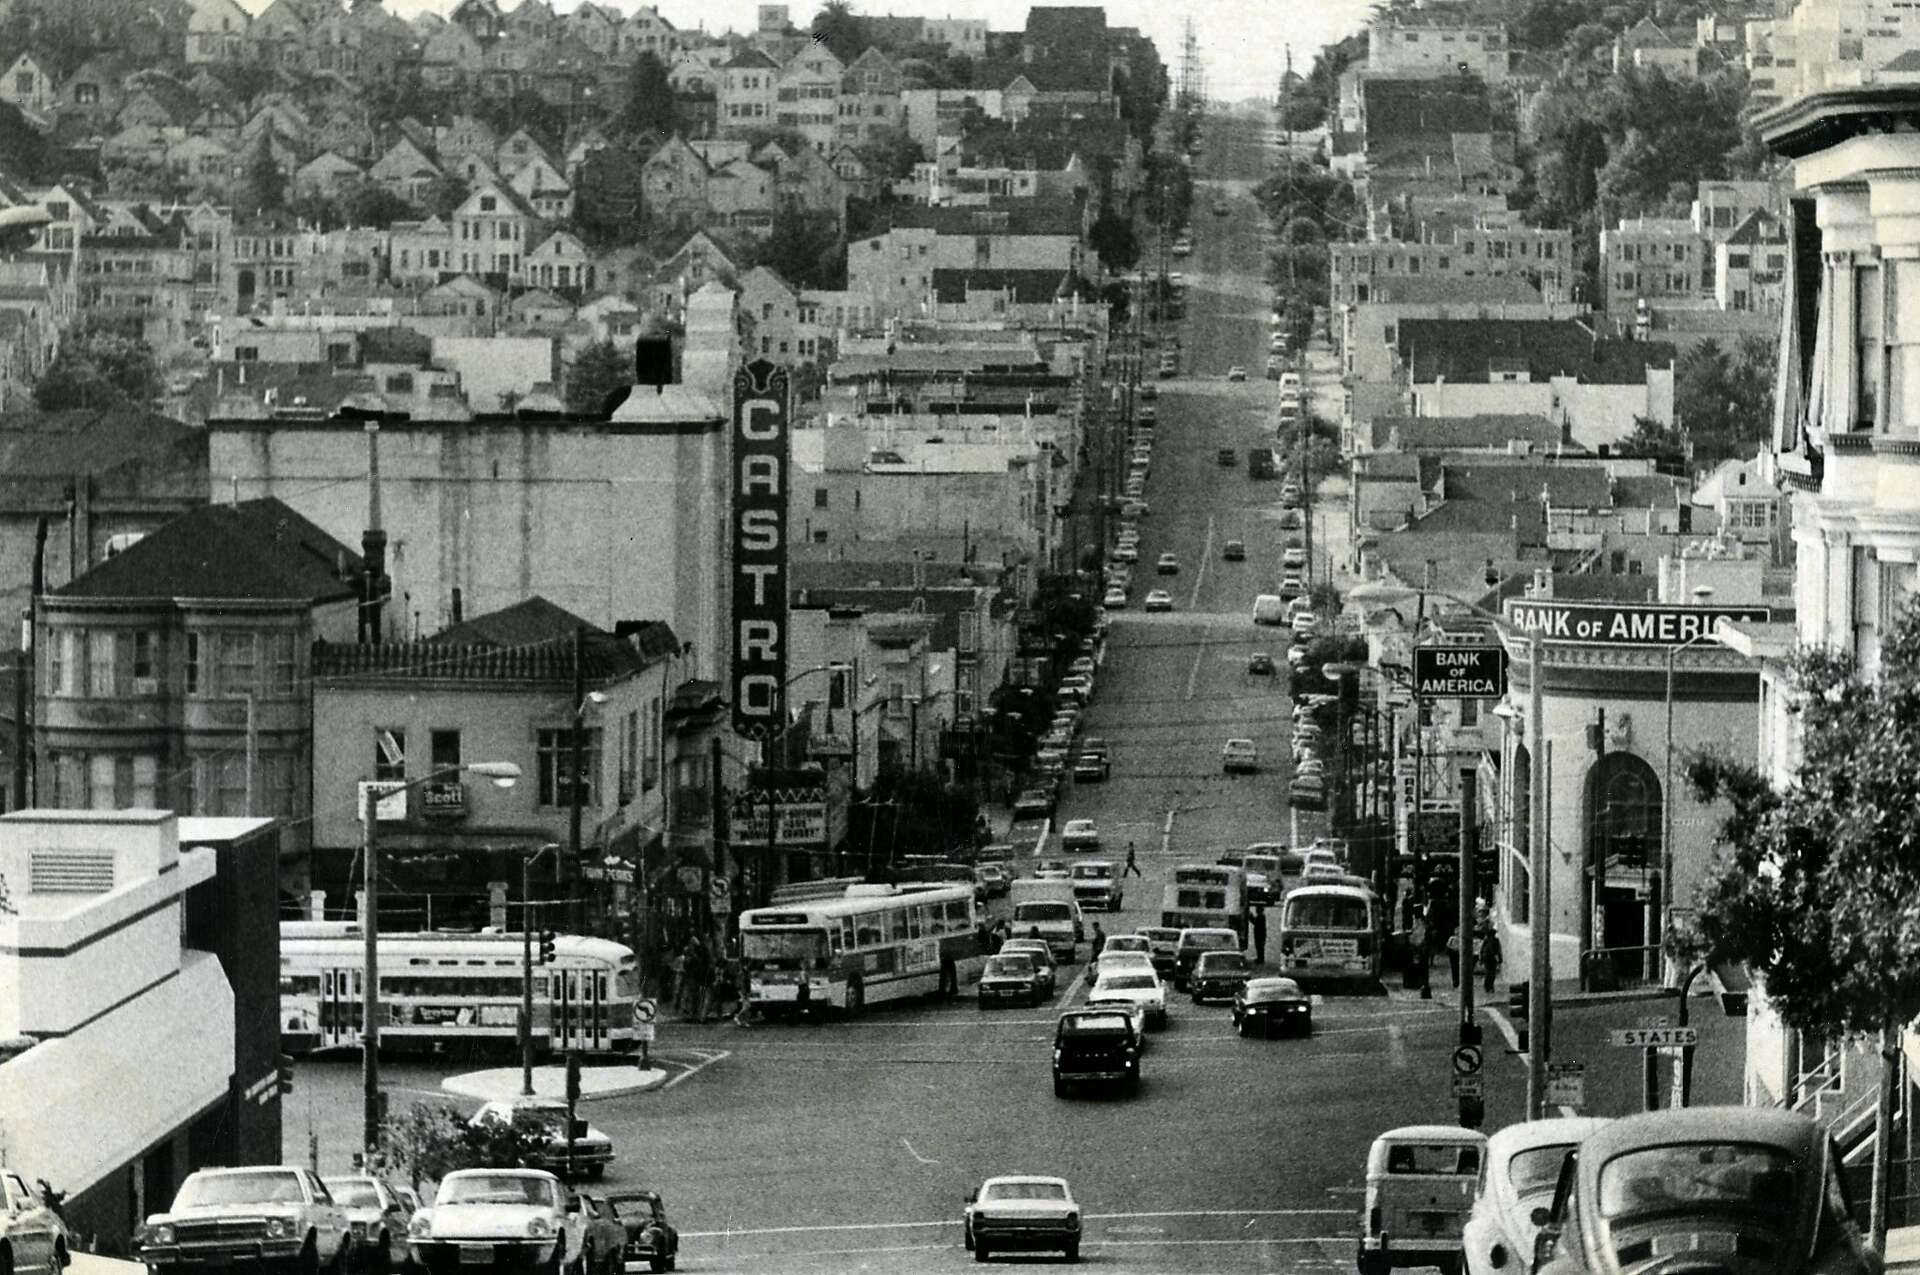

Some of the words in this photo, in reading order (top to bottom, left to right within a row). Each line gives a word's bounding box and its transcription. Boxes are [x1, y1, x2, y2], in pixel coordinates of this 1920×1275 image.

[741, 399, 779, 716] CASTRO
[1513, 608, 1570, 637] BANK
[1576, 620, 1603, 638] OF
[1436, 652, 1481, 666] BANK
[1449, 667, 1466, 678] OF
[1421, 679, 1494, 692] AMERICA
[1625, 1031, 1696, 1044] STATES
